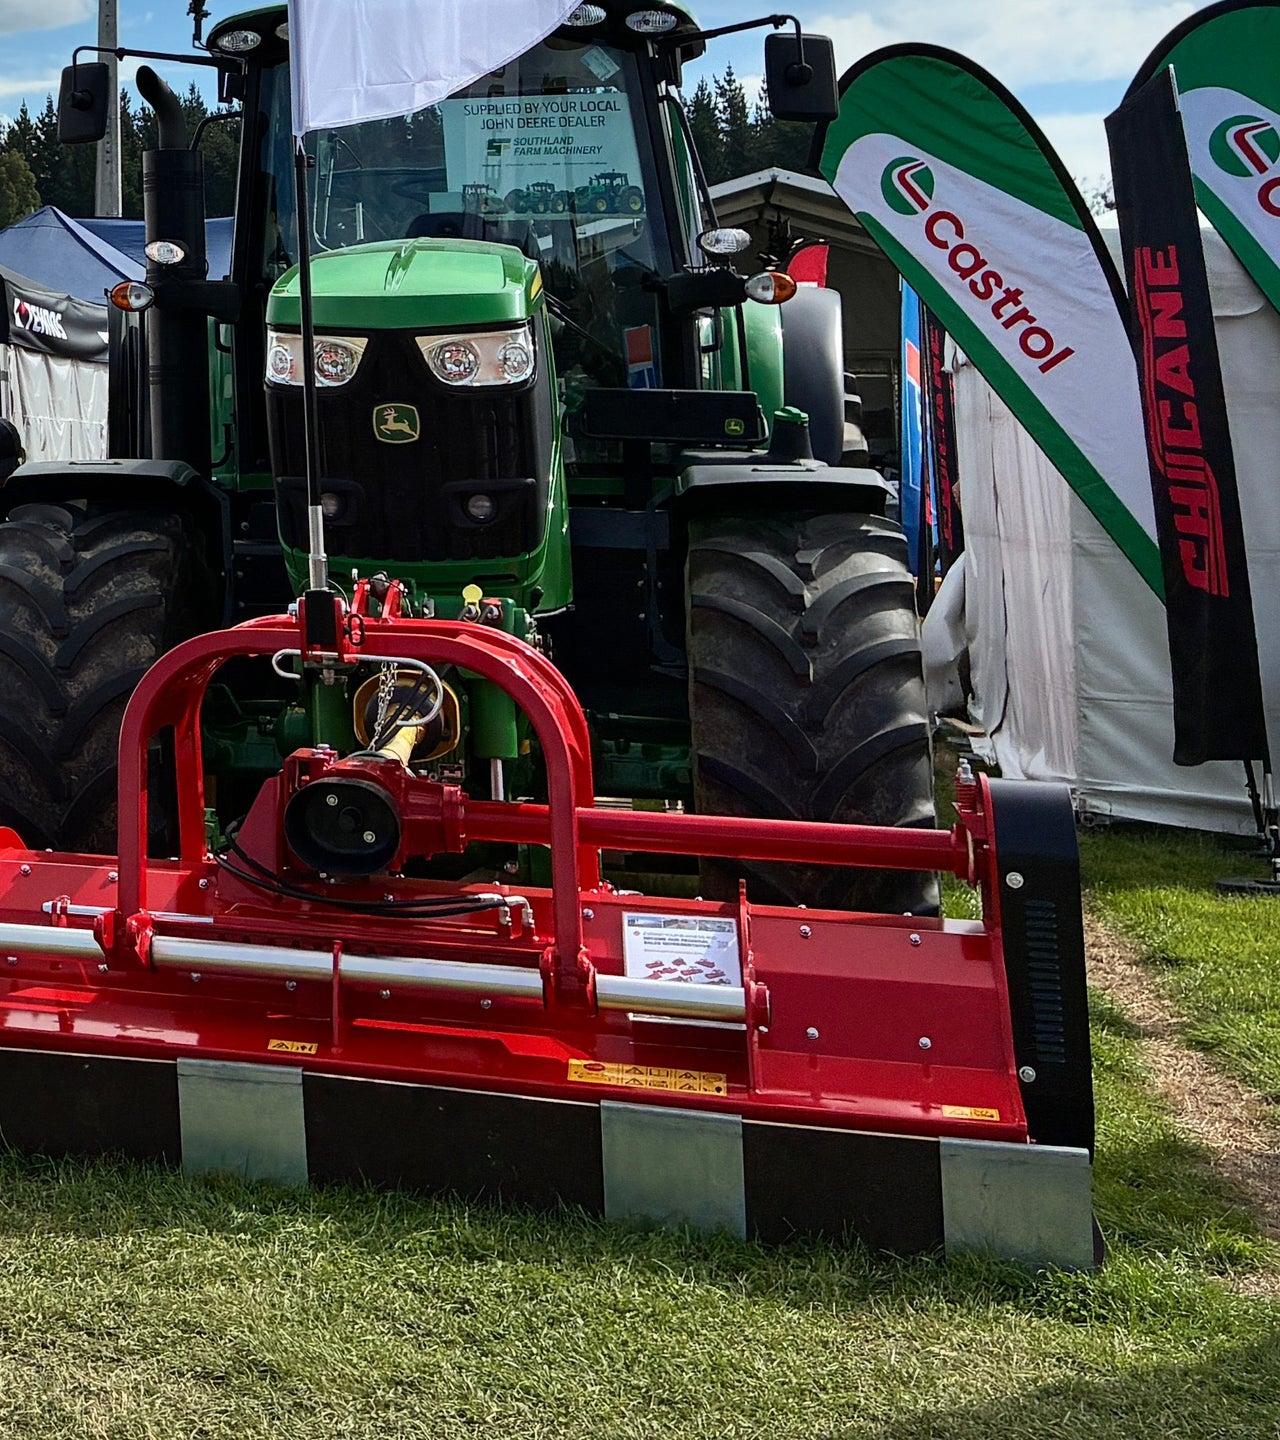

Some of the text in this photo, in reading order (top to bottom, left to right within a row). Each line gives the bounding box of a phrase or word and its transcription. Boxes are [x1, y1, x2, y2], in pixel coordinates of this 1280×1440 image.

[464, 100, 621, 116] SUPPLIED BY YOUR LOCAL
[480, 115, 605, 130] JOHN DEERE DEALER
[513, 136, 574, 146] SOUTHLAND
[513, 146, 603, 156] FARM MACHINERY
[924, 210, 1075, 374] Castrol
[1134, 244, 1229, 598] CHICANE
